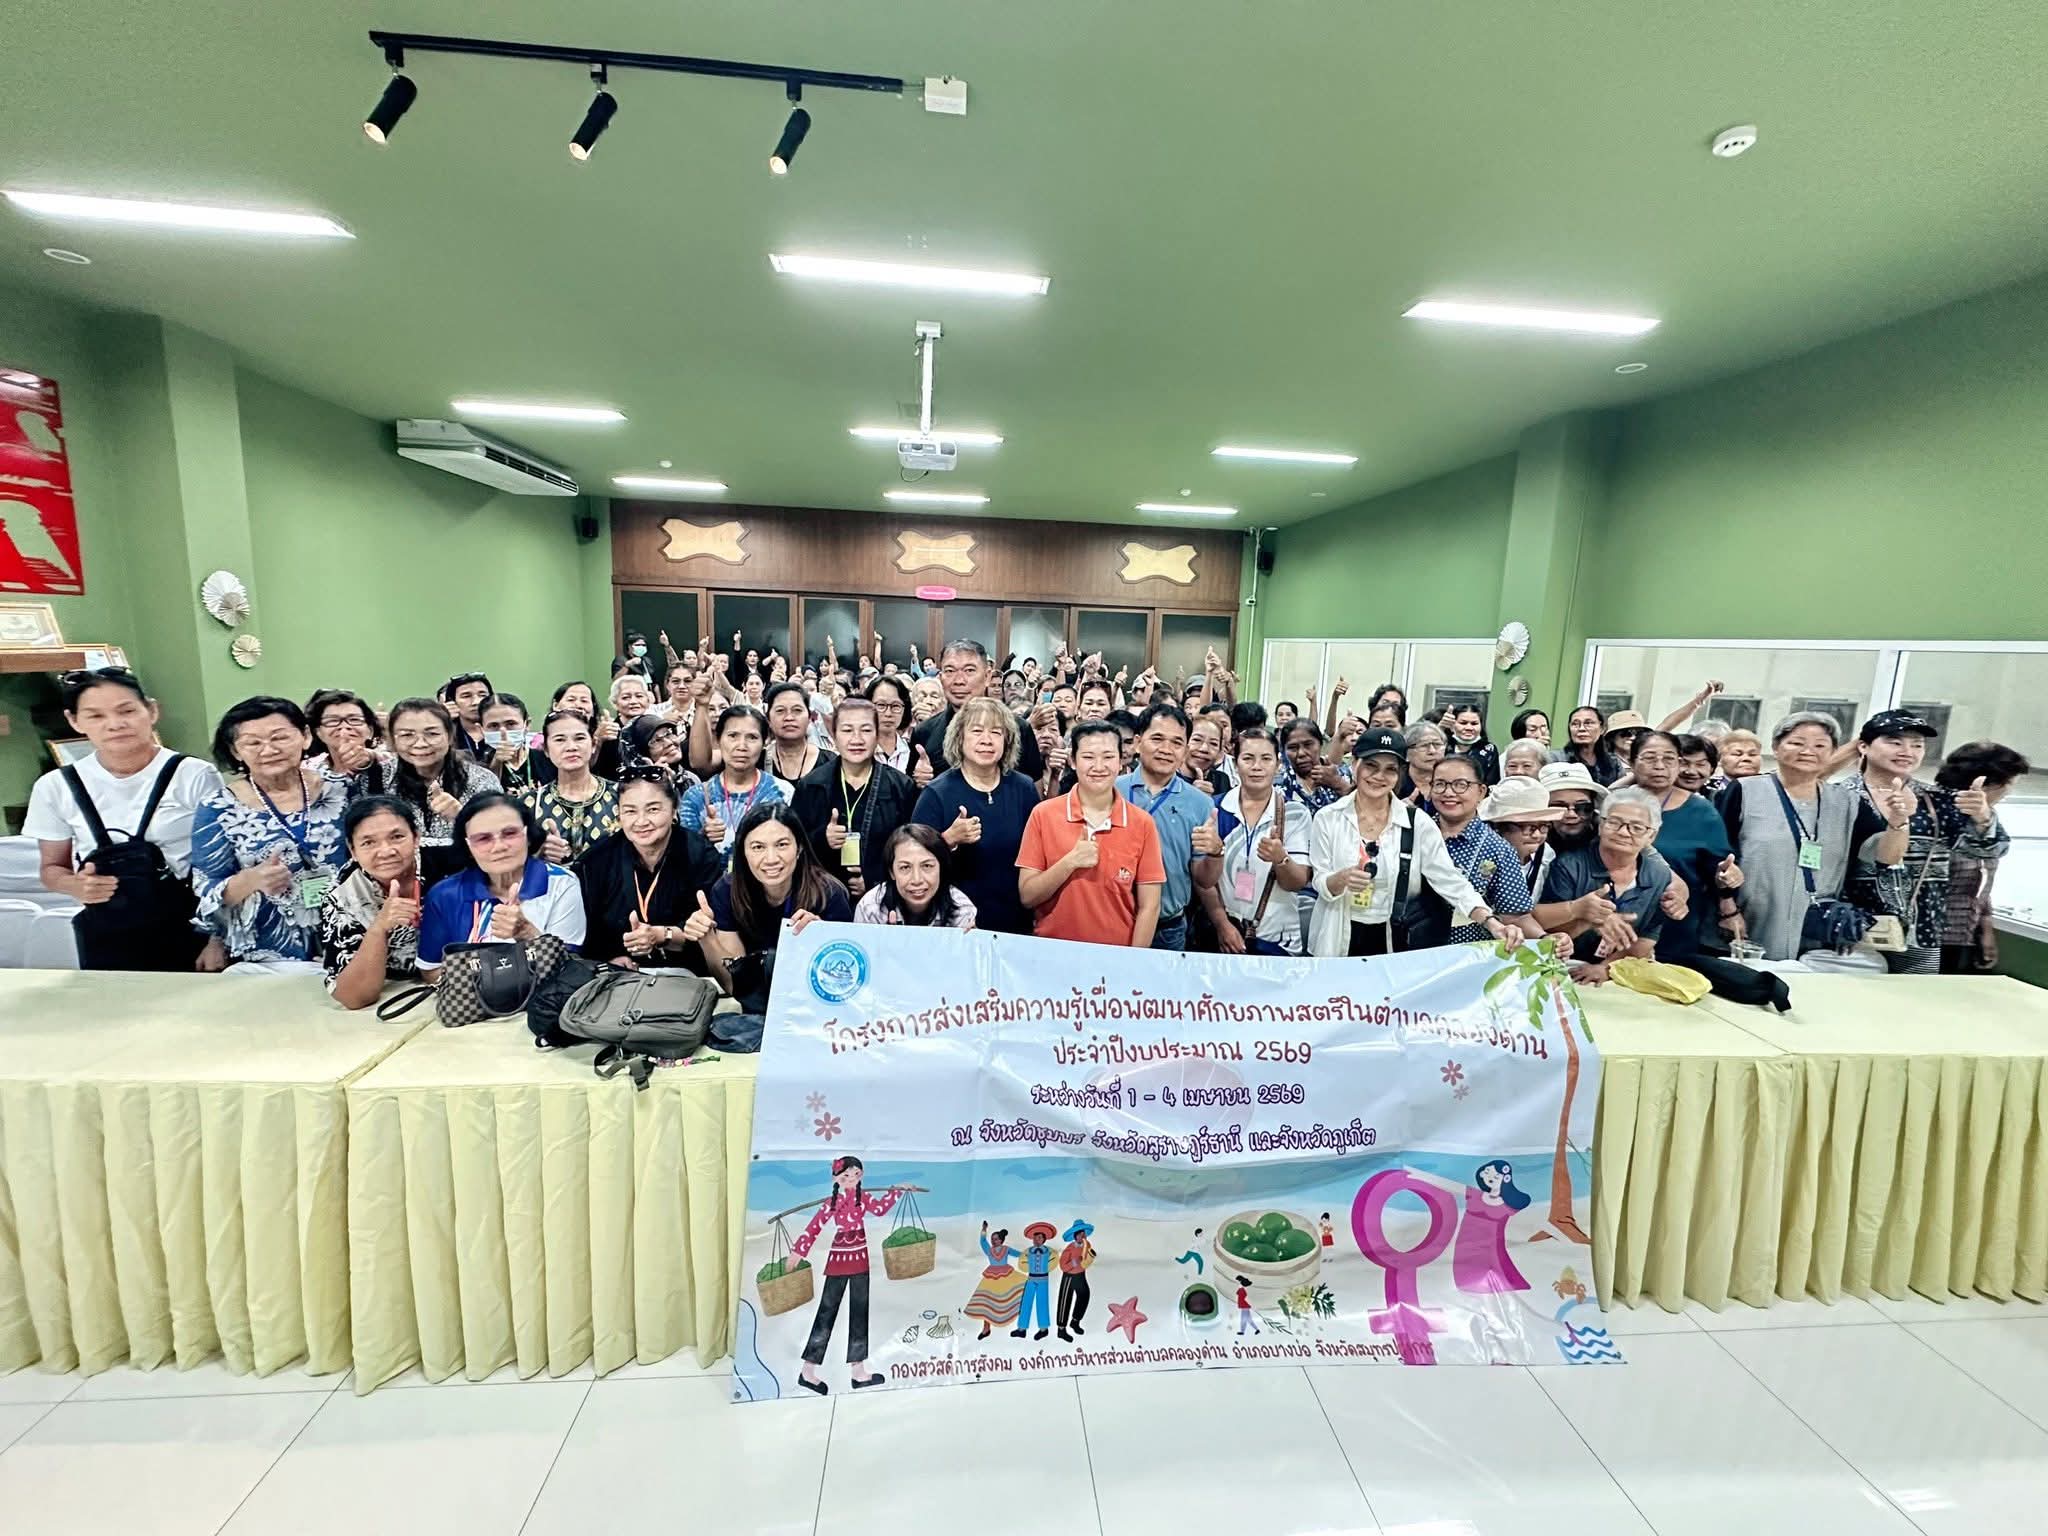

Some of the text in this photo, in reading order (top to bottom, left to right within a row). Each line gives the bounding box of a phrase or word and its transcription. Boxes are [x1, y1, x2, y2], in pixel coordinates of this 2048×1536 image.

[1053, 1034, 1312, 1065] ประจำปีงบประมาณ 2569
[1031, 1074, 1304, 1110] ระหว่างวันที่ 1 - 4 เมษายน 2569
[951, 1117, 1377, 1163] ณ จังหวัดชุมพร จังหวัดสุราษฎร์ธานี และจังหวัดภูเก็ต
[1018, 1344, 1228, 1371] องค์การบริหารส่วนตำบลคลองด่าน
[1232, 1339, 1312, 1360] อำเภอบางบ่อ
[1315, 1338, 1434, 1363] จังหวัดสมุทรปการ
